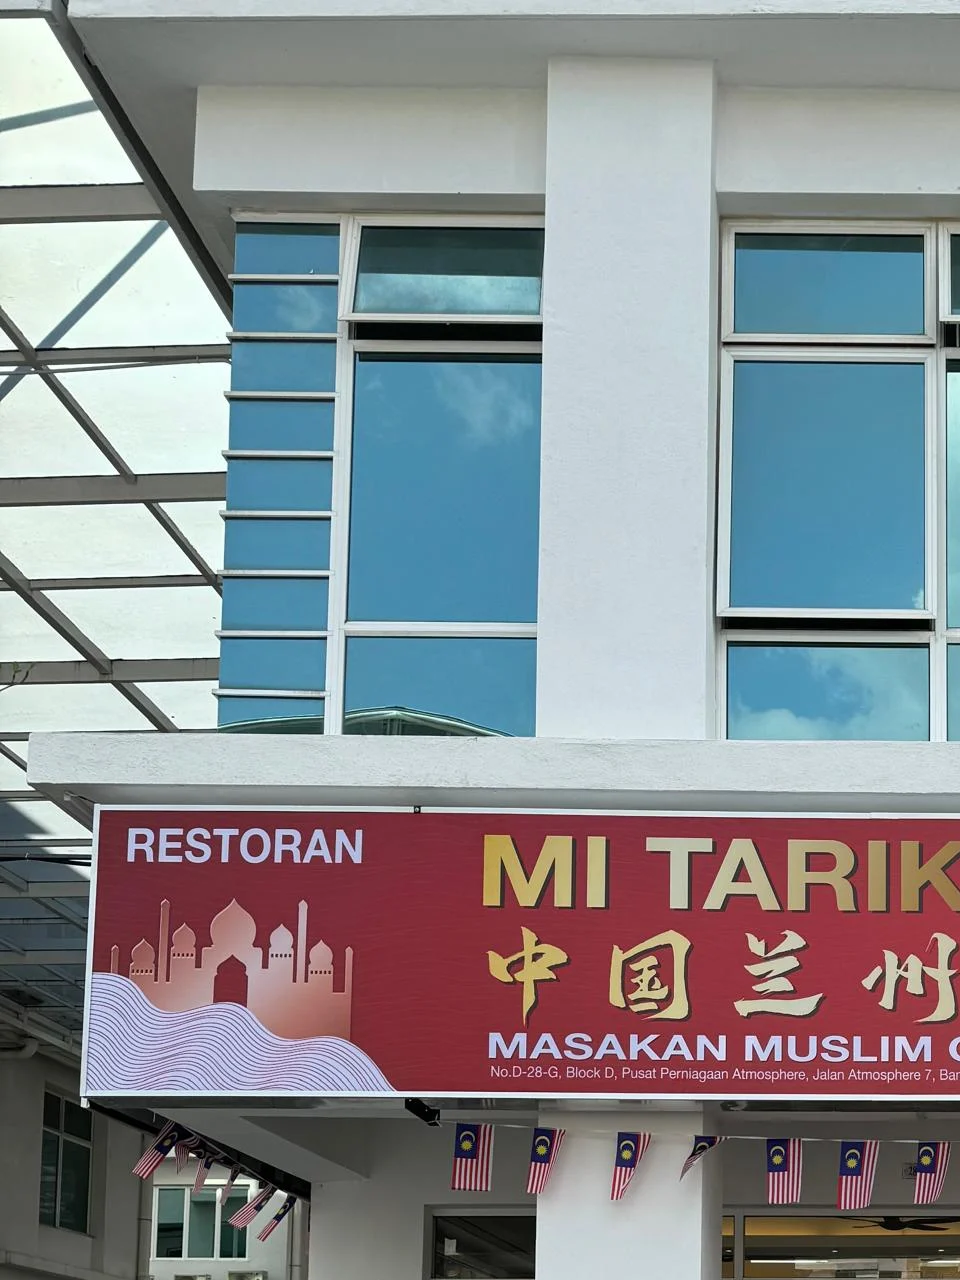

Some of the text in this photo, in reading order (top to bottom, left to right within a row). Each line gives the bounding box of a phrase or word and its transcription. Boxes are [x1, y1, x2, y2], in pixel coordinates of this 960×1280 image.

[126, 827, 363, 864] RESTORAN
[482, 834, 607, 908] MI
[488, 1032, 727, 1062] MASAKAN
[744, 1035, 932, 1064] MUSLIM
[490, 1065, 562, 1081] No.D-28-G,
[566, 1066, 601, 1080] Block
[604, 1066, 618, 1082] D,
[621, 1066, 657, 1080] Pusat
[660, 1067, 729, 1084] Perniagaan
[731, 1067, 809, 1084] Atmosphere,
[812, 1068, 845, 1082] Jalan
[847, 1068, 921, 1084] Atmosphere
[924, 1068, 936, 1083] 7,
